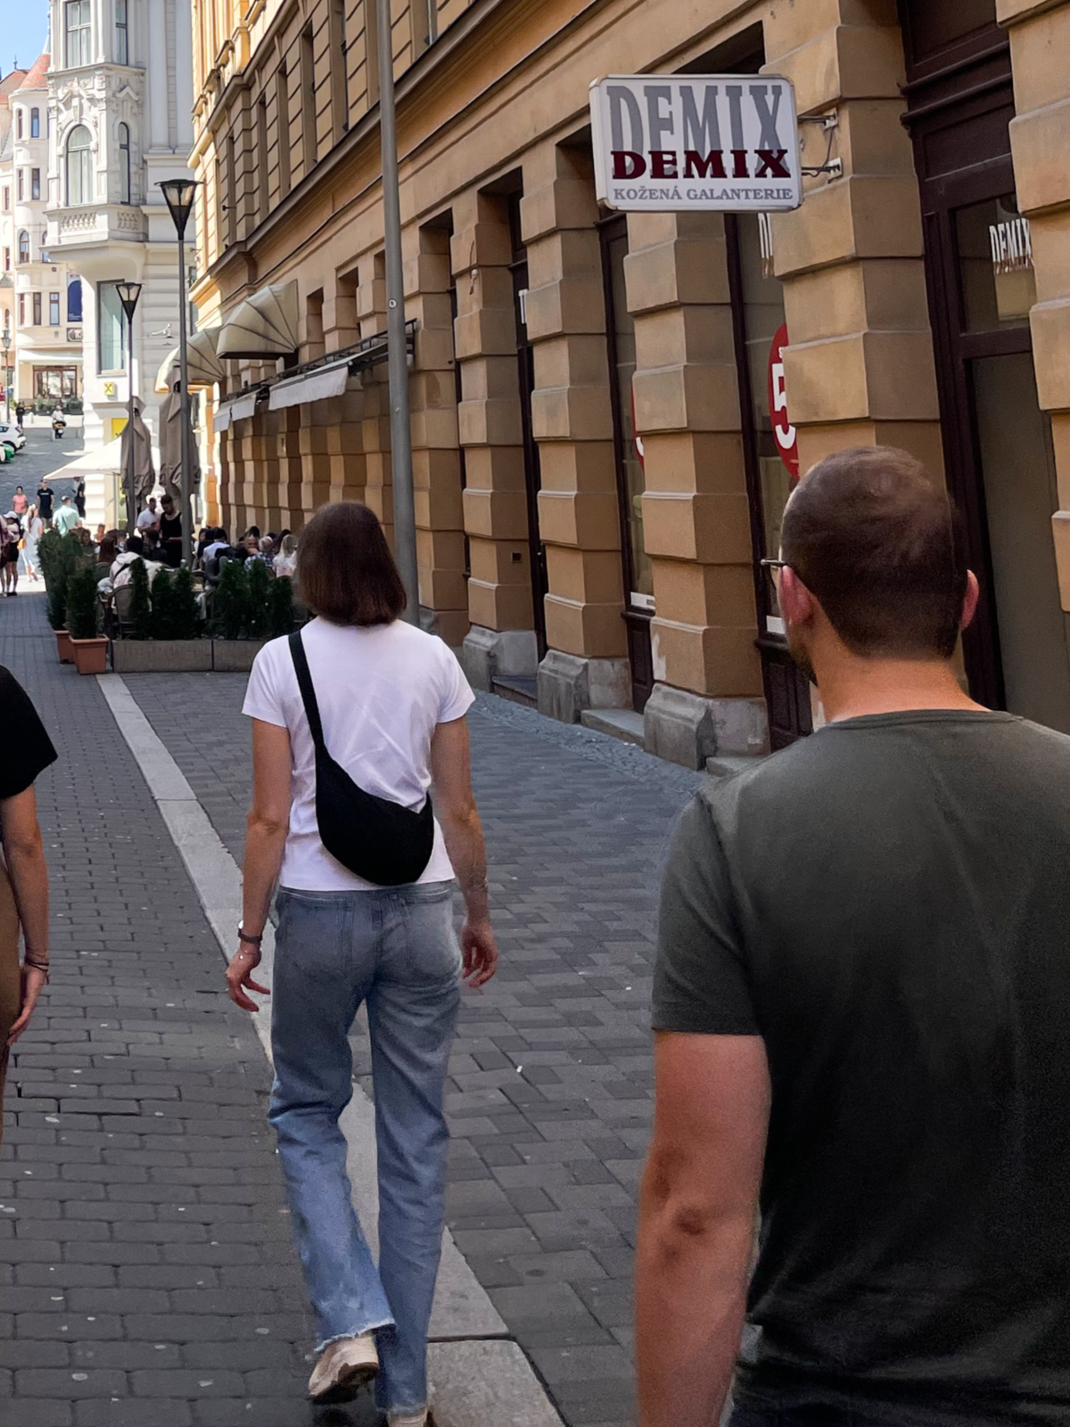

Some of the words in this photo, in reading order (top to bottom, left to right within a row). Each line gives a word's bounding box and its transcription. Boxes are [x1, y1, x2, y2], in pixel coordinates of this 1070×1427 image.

[606, 85, 790, 174] DEMIX
[610, 149, 792, 180] DEMIX
[613, 185, 683, 201] KOŽENÁ
[686, 188, 793, 201] GALANTERIE
[989, 217, 1033, 263] DEMIX
